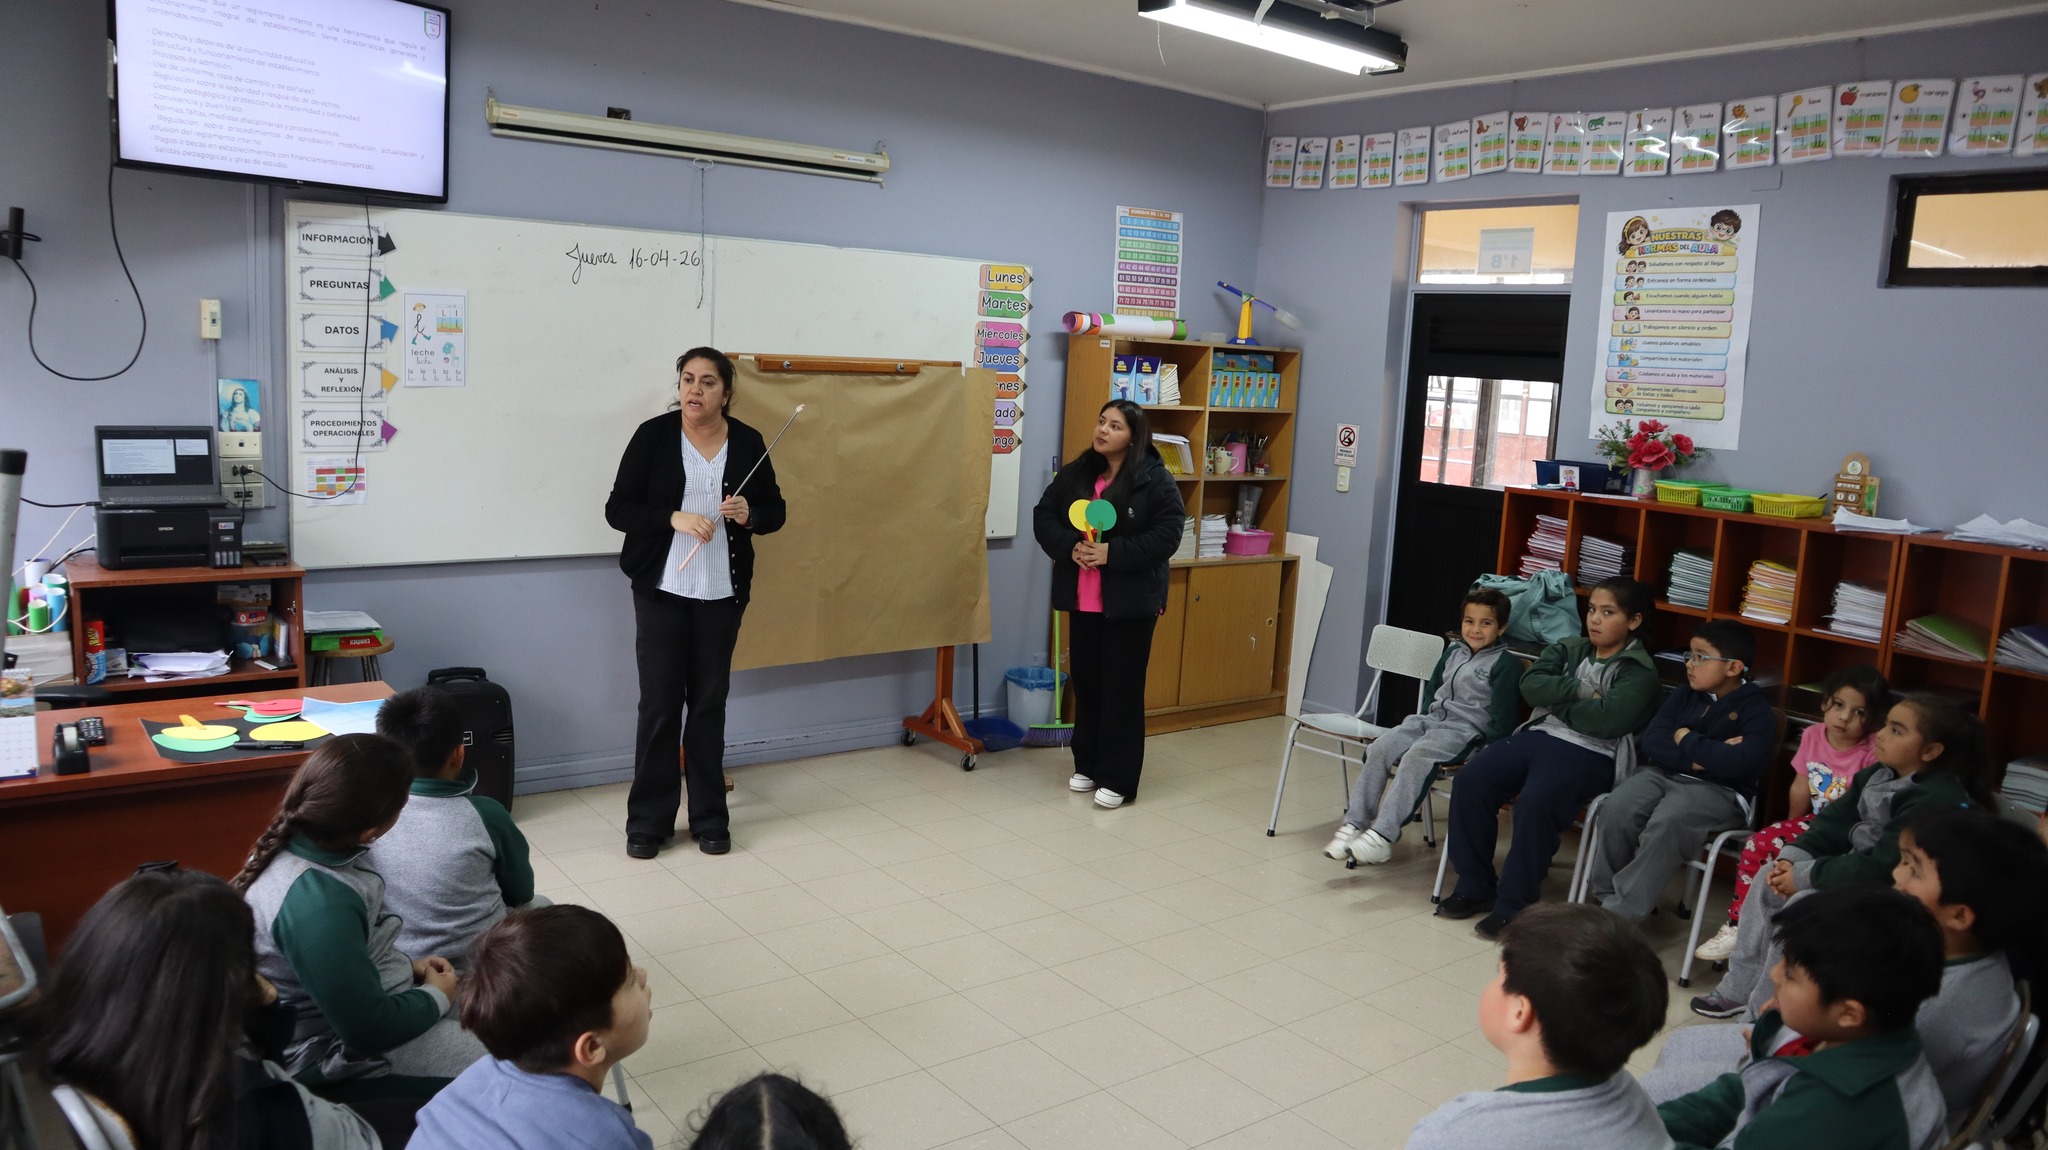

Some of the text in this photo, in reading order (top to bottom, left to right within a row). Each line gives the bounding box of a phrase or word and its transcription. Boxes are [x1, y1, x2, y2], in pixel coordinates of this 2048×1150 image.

[152, 38, 191, 52] Estructura
[152, 49, 185, 61] Procesos
[243, 45, 282, 59] comunidad
[244, 77, 270, 87] cambio
[153, 92, 197, 105] Convivencia
[205, 100, 223, 109] buen
[203, 121, 223, 129] sobre
[228, 124, 280, 139] procedimientos
[194, 130, 234, 143] reglamento
[154, 145, 180, 154] Salidas
[302, 233, 374, 245] INFORMACIÓN
[1651, 231, 1702, 242] NUESTRAS
[1638, 243, 1679, 255] NORMAS
[1690, 243, 1718, 254] AULA
[566, 242, 700, 284] Jueves 16-04-26
[987, 270, 1023, 284] Lunes
[310, 279, 370, 290] PREGUNTAS
[982, 296, 1027, 311] Martes
[324, 326, 360, 335] DATOS
[976, 328, 1024, 341] Miércoles
[976, 352, 1020, 365] Jueves
[324, 366, 358, 375] ANÁLISIS
[995, 407, 1016, 418] ado
